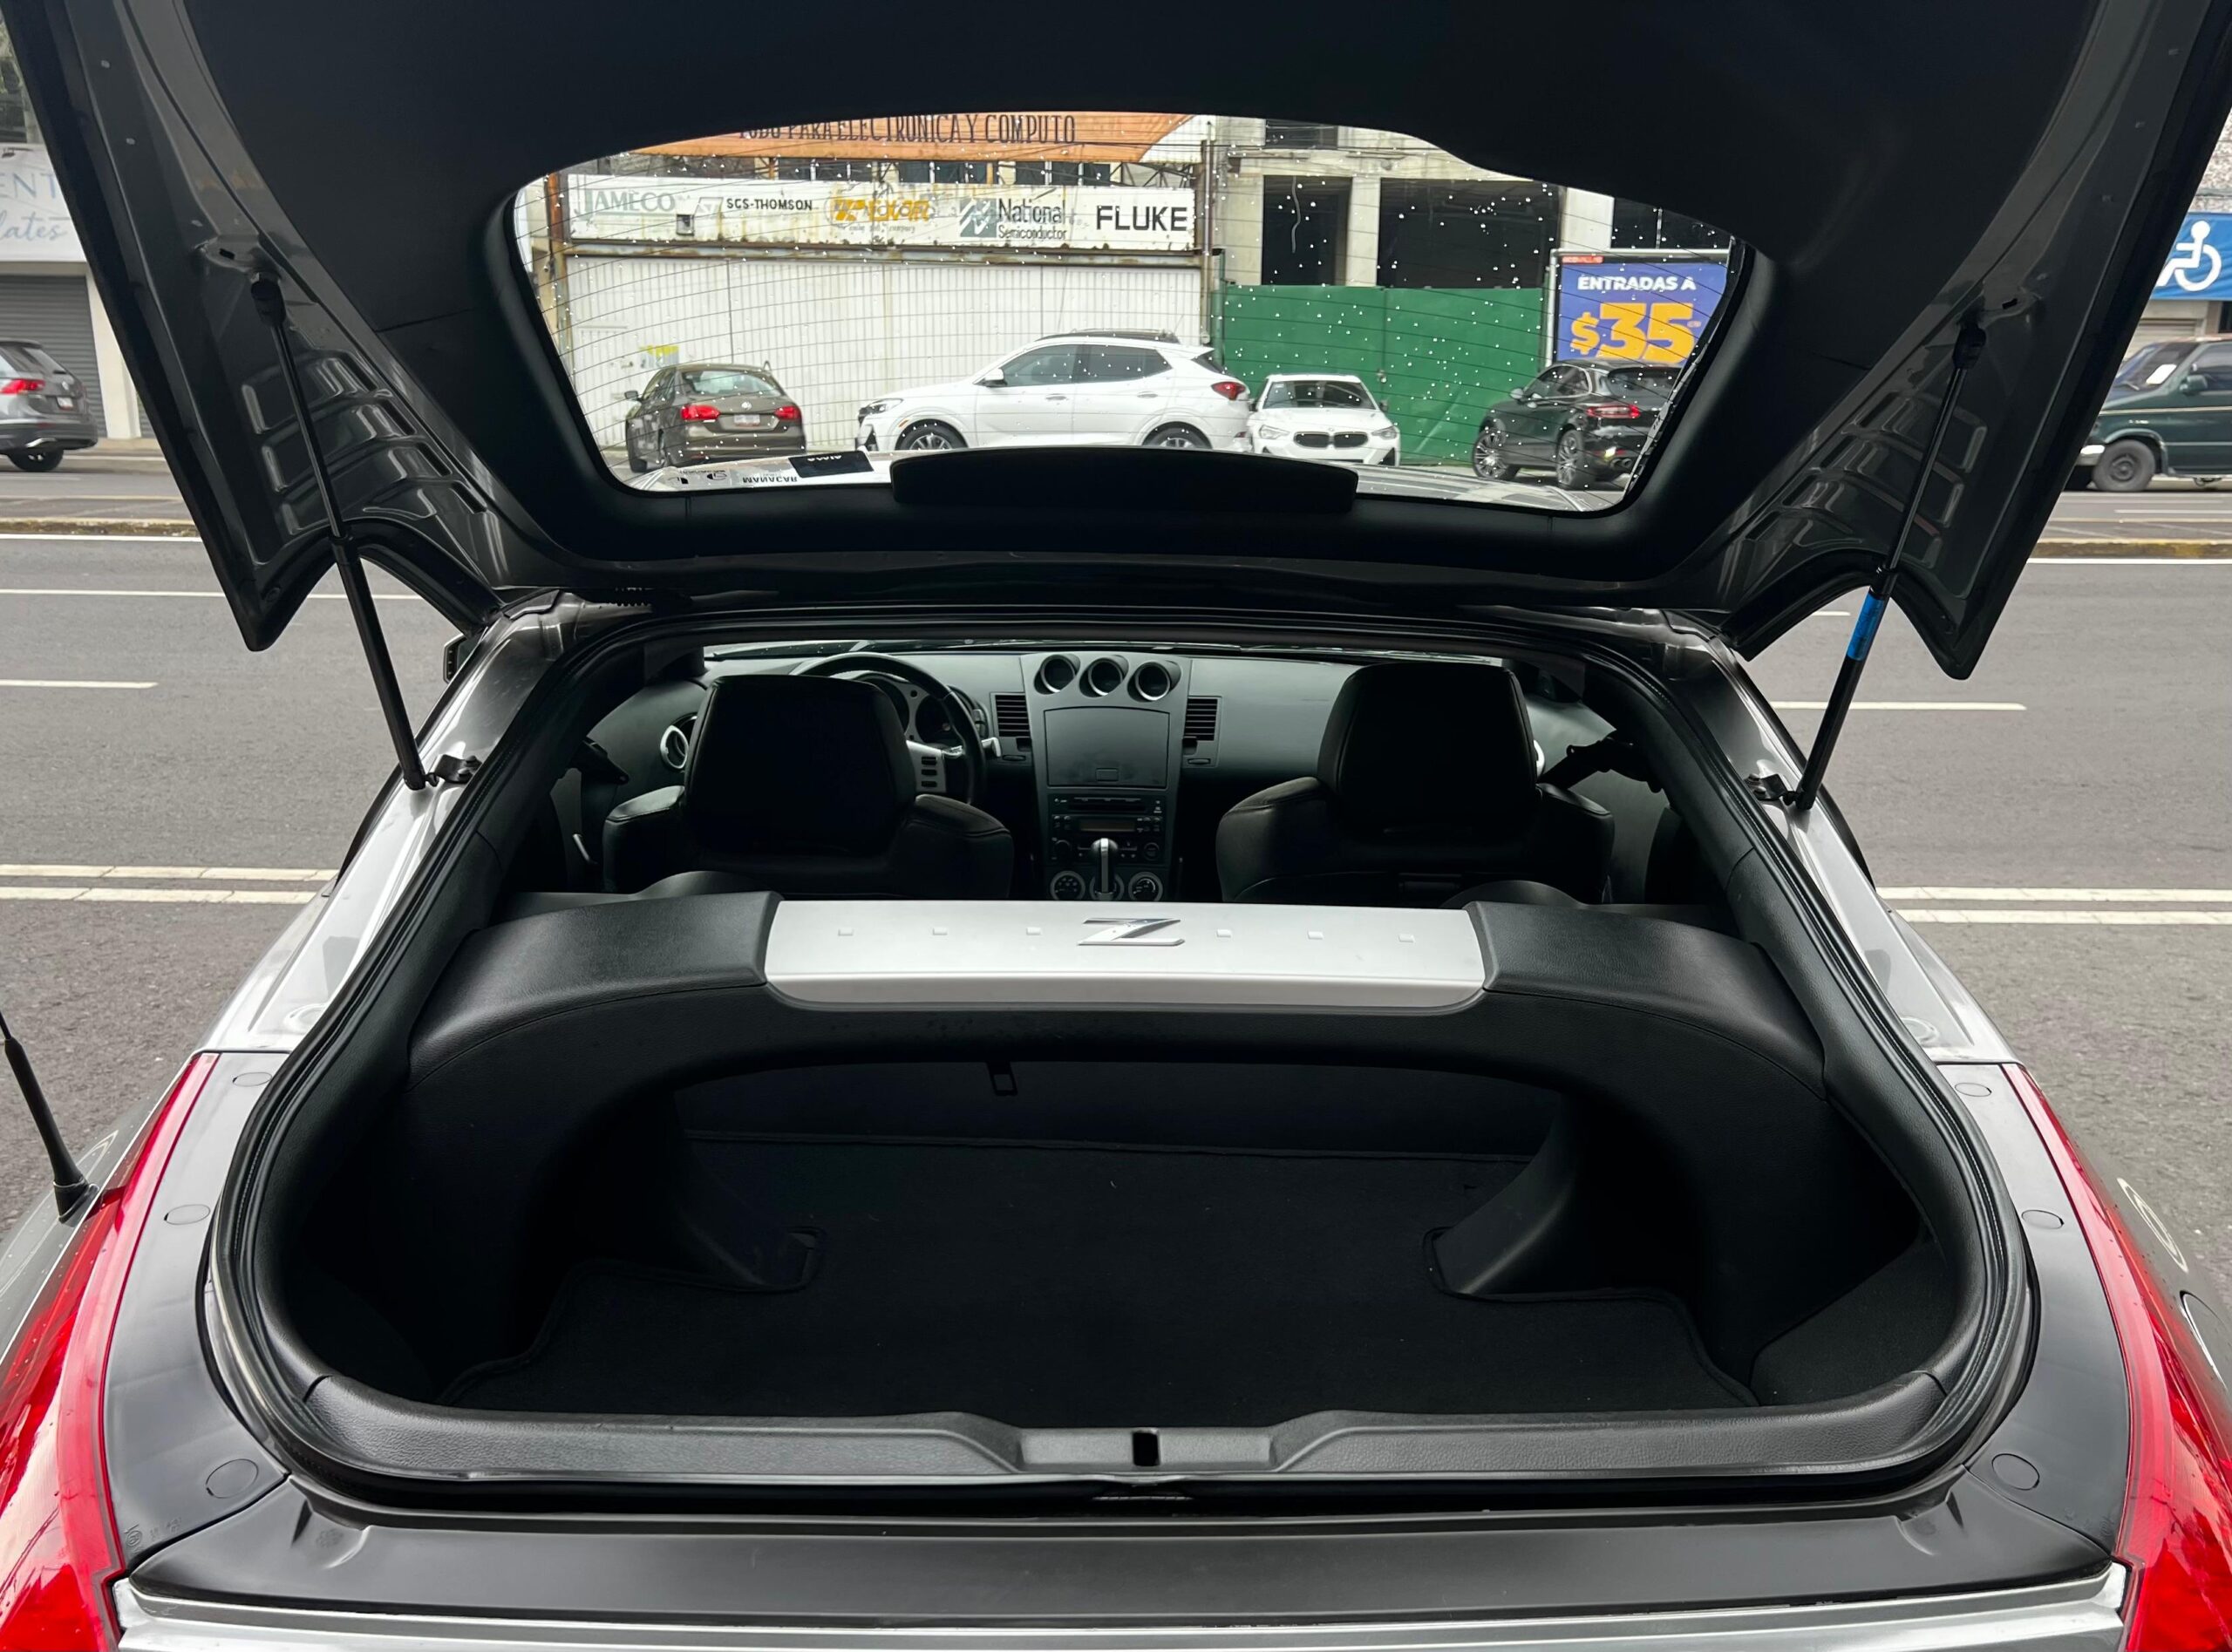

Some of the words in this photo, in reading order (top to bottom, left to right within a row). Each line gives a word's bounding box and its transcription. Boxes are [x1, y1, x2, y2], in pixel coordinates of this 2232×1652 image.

[985, 114, 1075, 144] COMPUTO
[575, 188, 676, 220] JAMECO
[998, 198, 1065, 225] National
[1096, 205, 1187, 231] FLUKE
[998, 225, 1067, 240] Semiconductor
[1577, 275, 1677, 290] ENTRADAS
[1681, 276, 1697, 290] A
[1570, 303, 1695, 364] $35
[1077, 917, 1186, 947] Z
